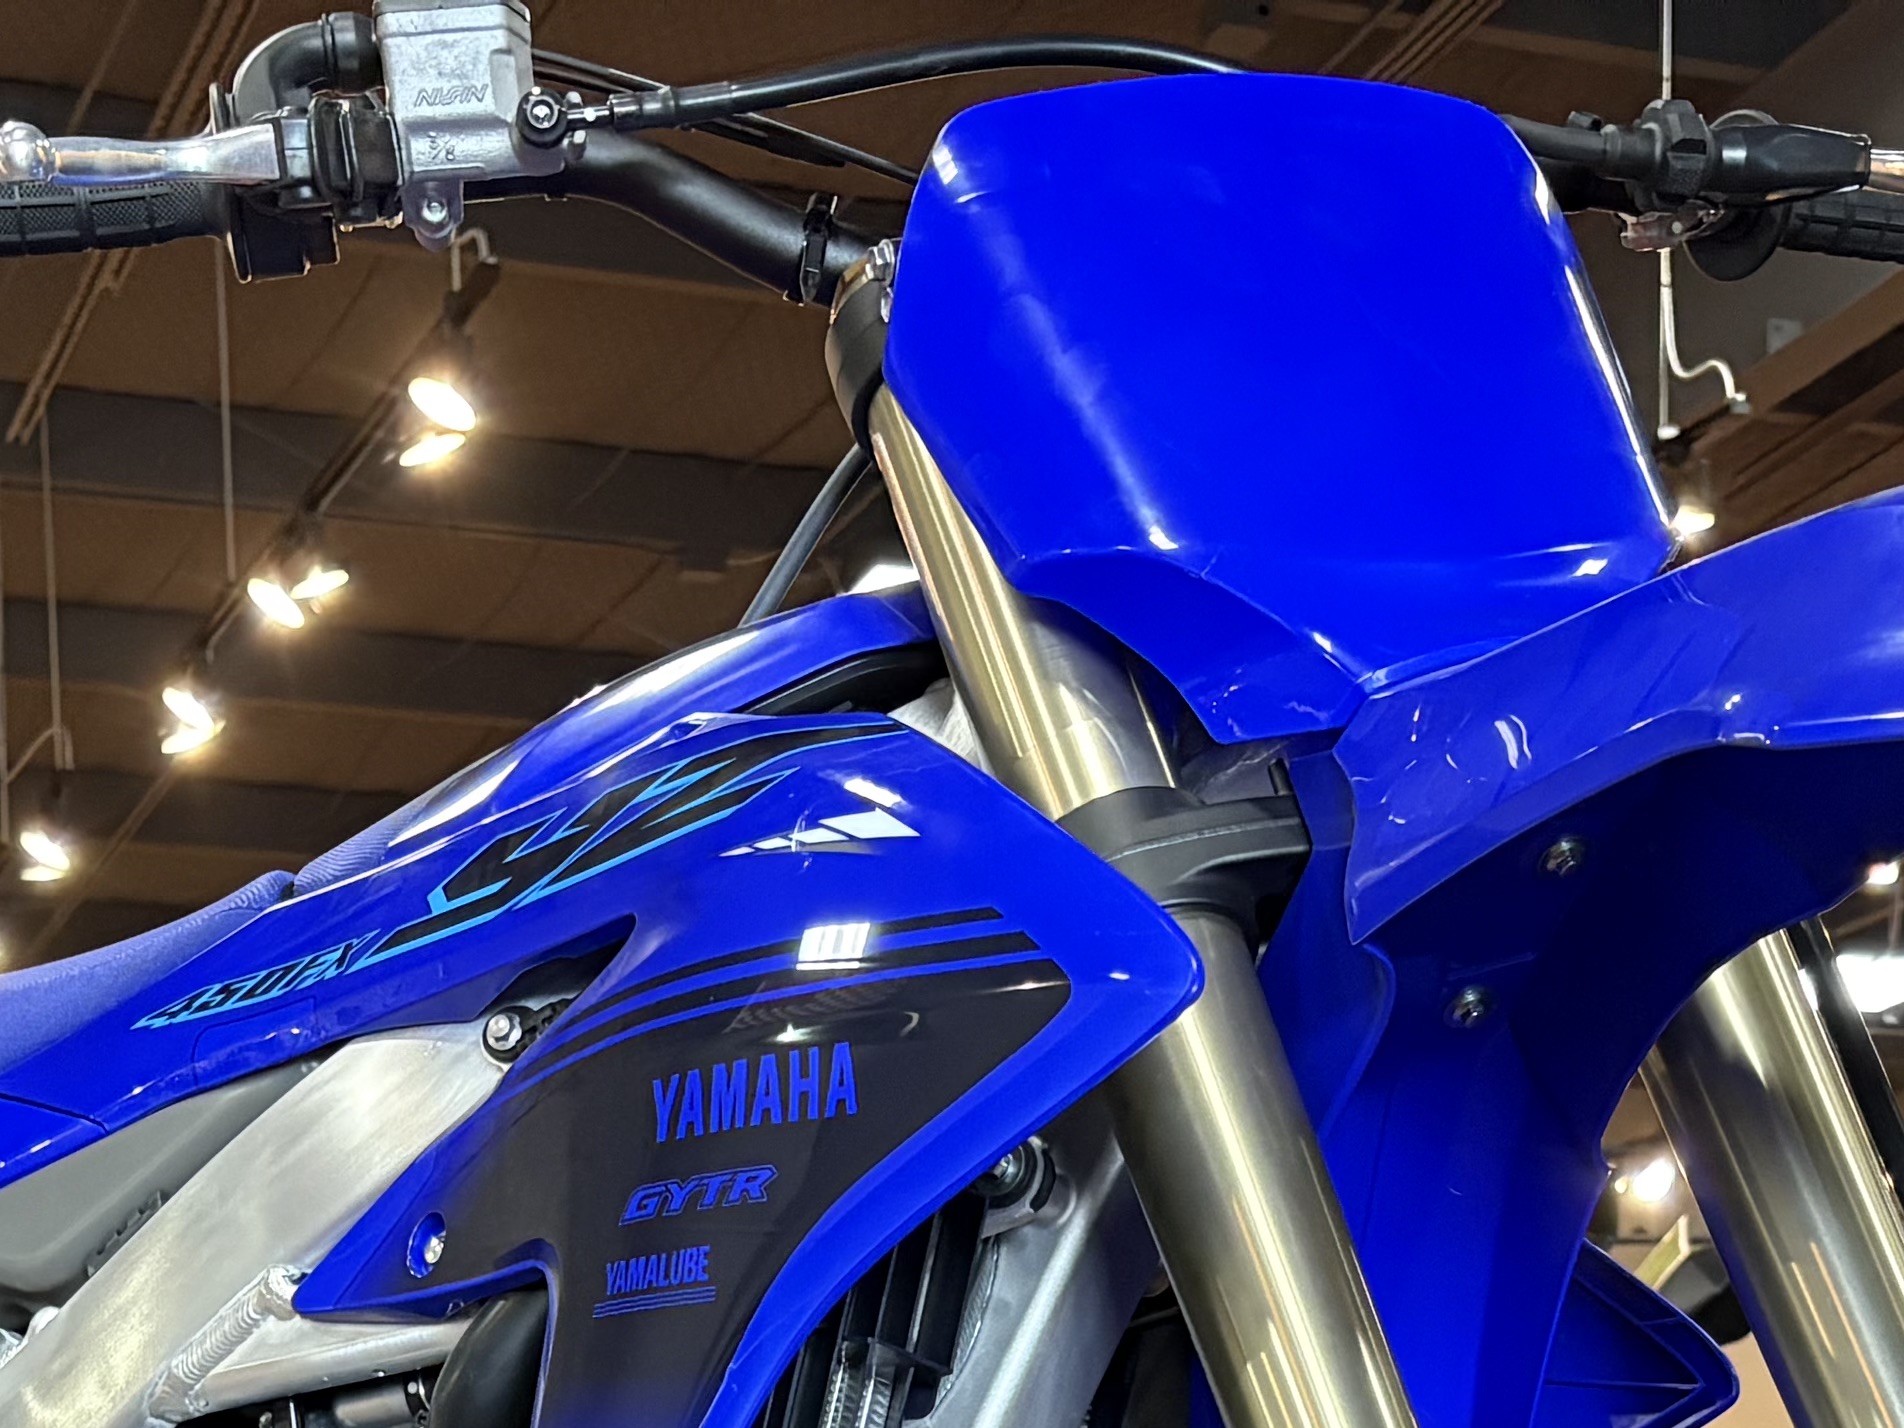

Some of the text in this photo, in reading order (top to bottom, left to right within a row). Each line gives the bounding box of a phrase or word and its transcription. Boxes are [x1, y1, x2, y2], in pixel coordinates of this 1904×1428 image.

[652, 1041, 858, 1143] YAMAHA
[619, 1165, 779, 1226] GYTR
[605, 1245, 712, 1297] YAMALUBE
